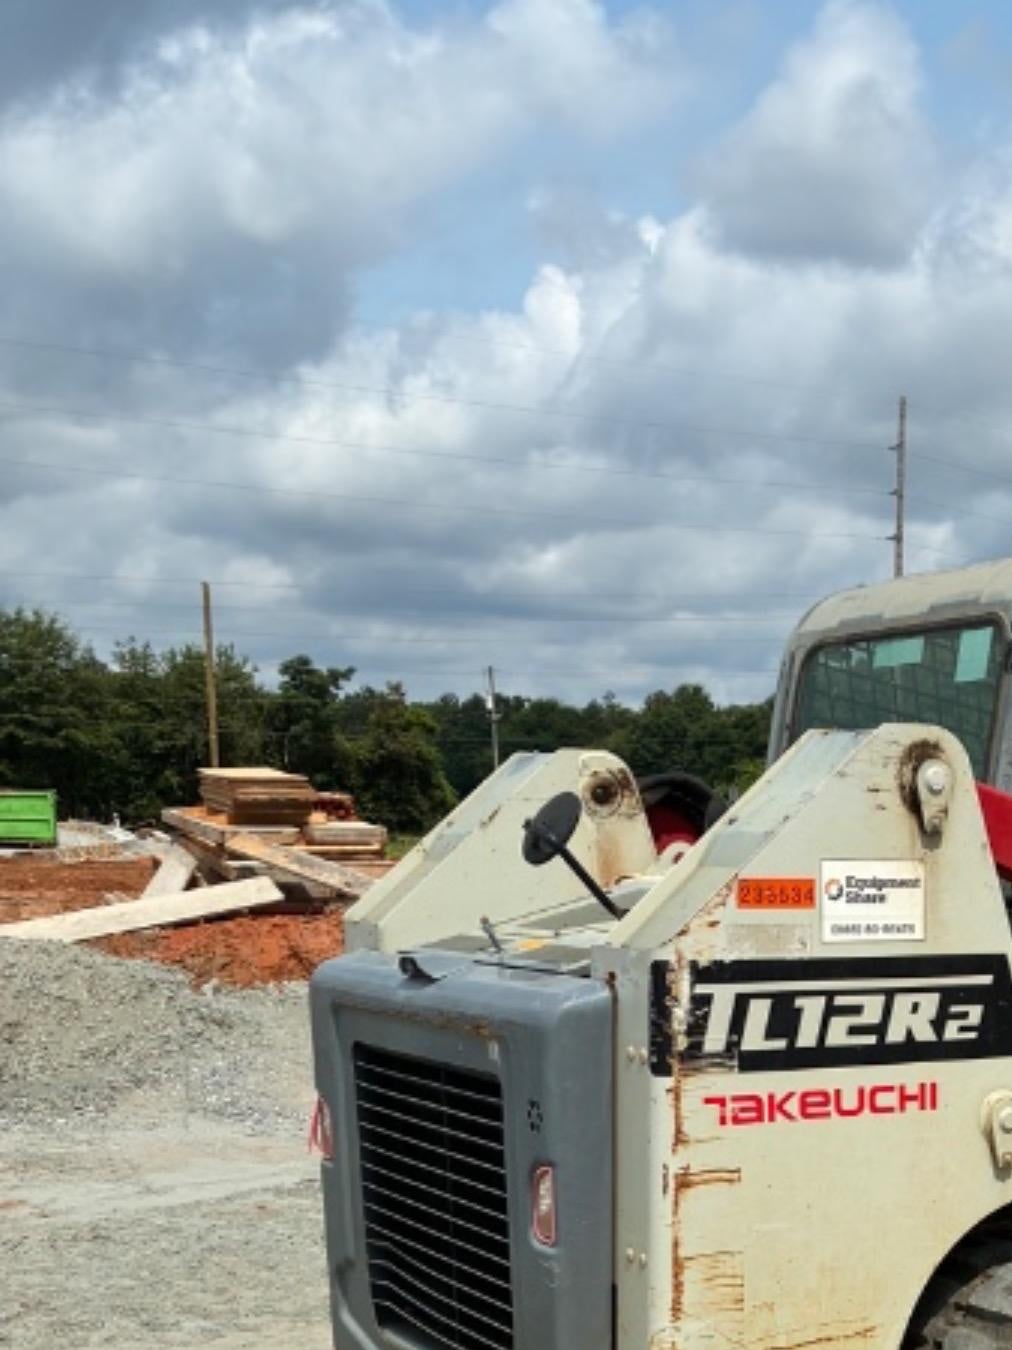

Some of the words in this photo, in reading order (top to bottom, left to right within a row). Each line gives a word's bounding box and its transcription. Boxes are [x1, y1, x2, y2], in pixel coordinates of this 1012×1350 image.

[844, 875, 922, 891] Equipment
[844, 890, 886, 904] Share
[692, 973, 994, 1055] TL12R2
